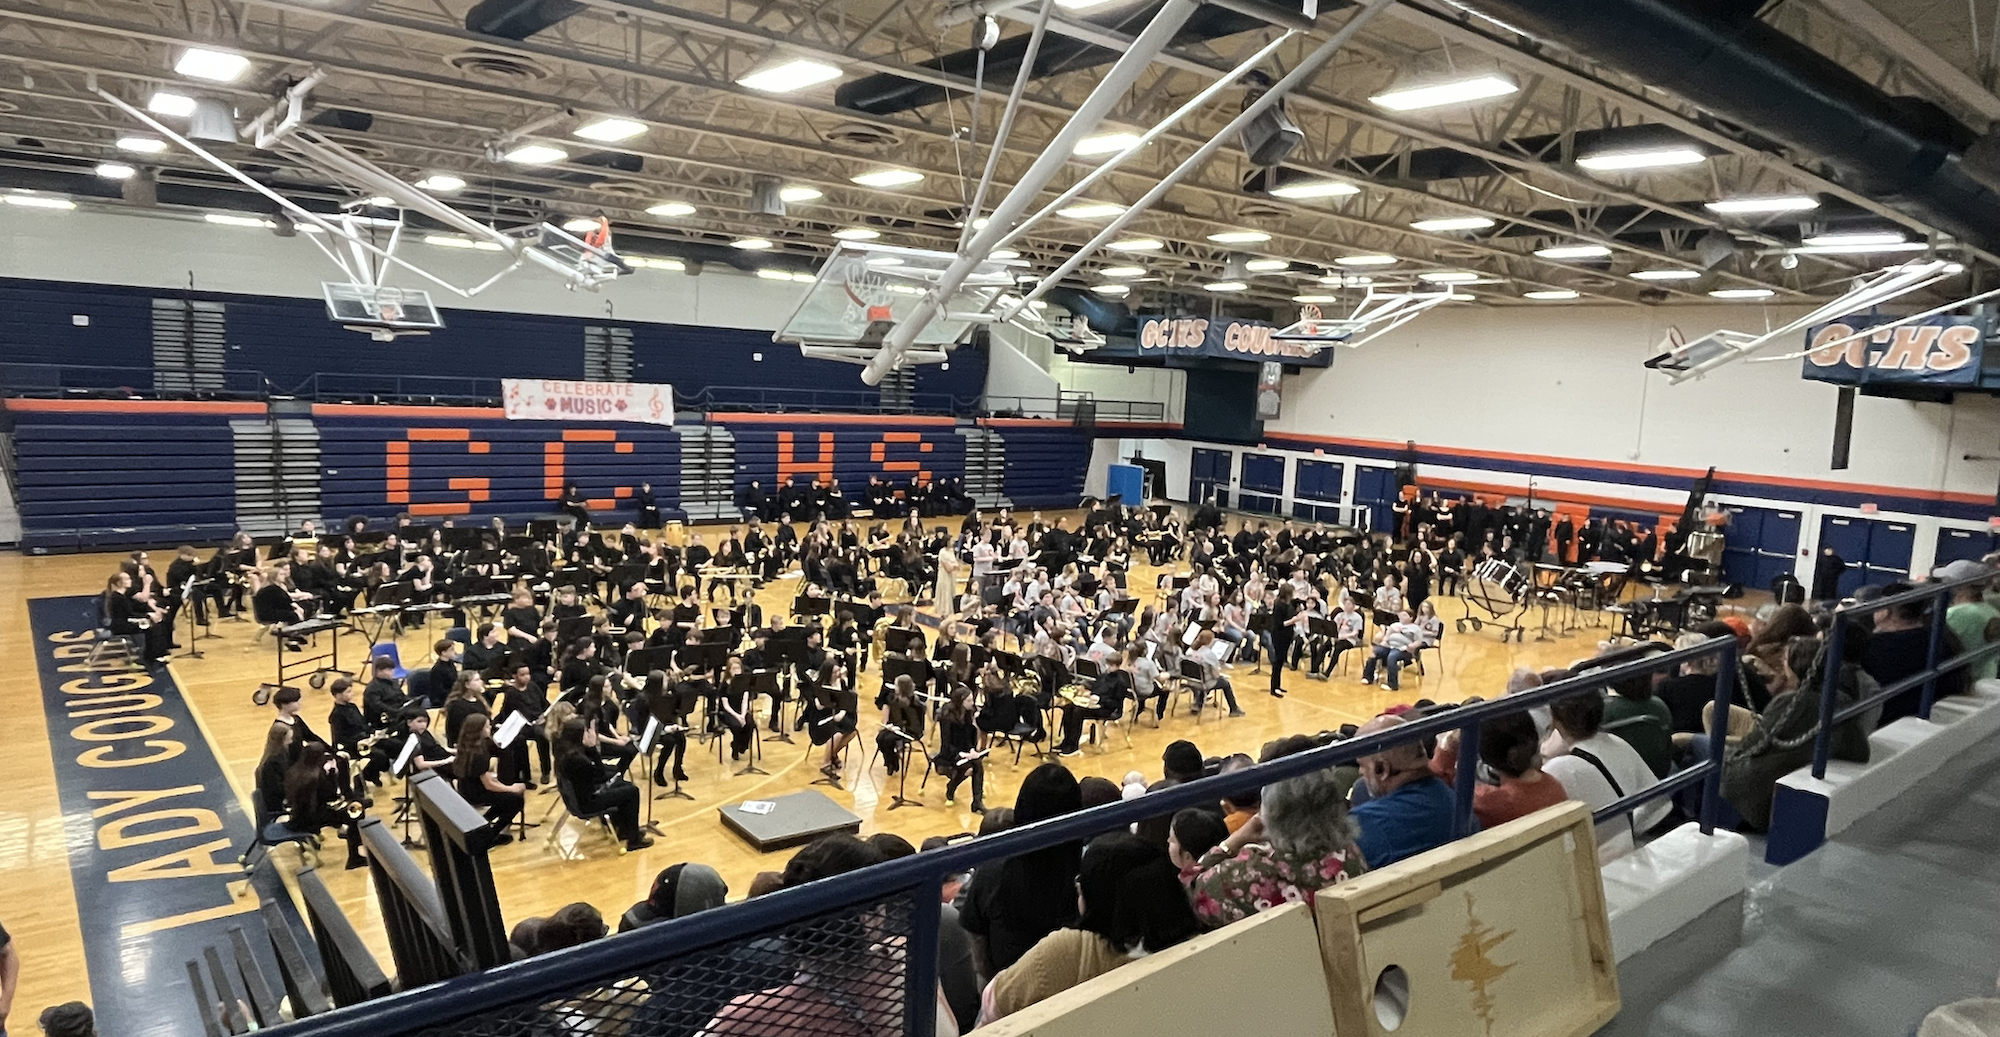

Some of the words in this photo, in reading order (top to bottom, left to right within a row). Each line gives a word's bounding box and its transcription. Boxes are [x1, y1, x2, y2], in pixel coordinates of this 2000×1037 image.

[1141, 318, 1209, 348] GCHS
[1809, 323, 1980, 371] GCHS
[541, 381, 634, 397] CELEBRATE
[560, 397, 612, 415] MUSIC
[87, 784, 261, 936] LADY
